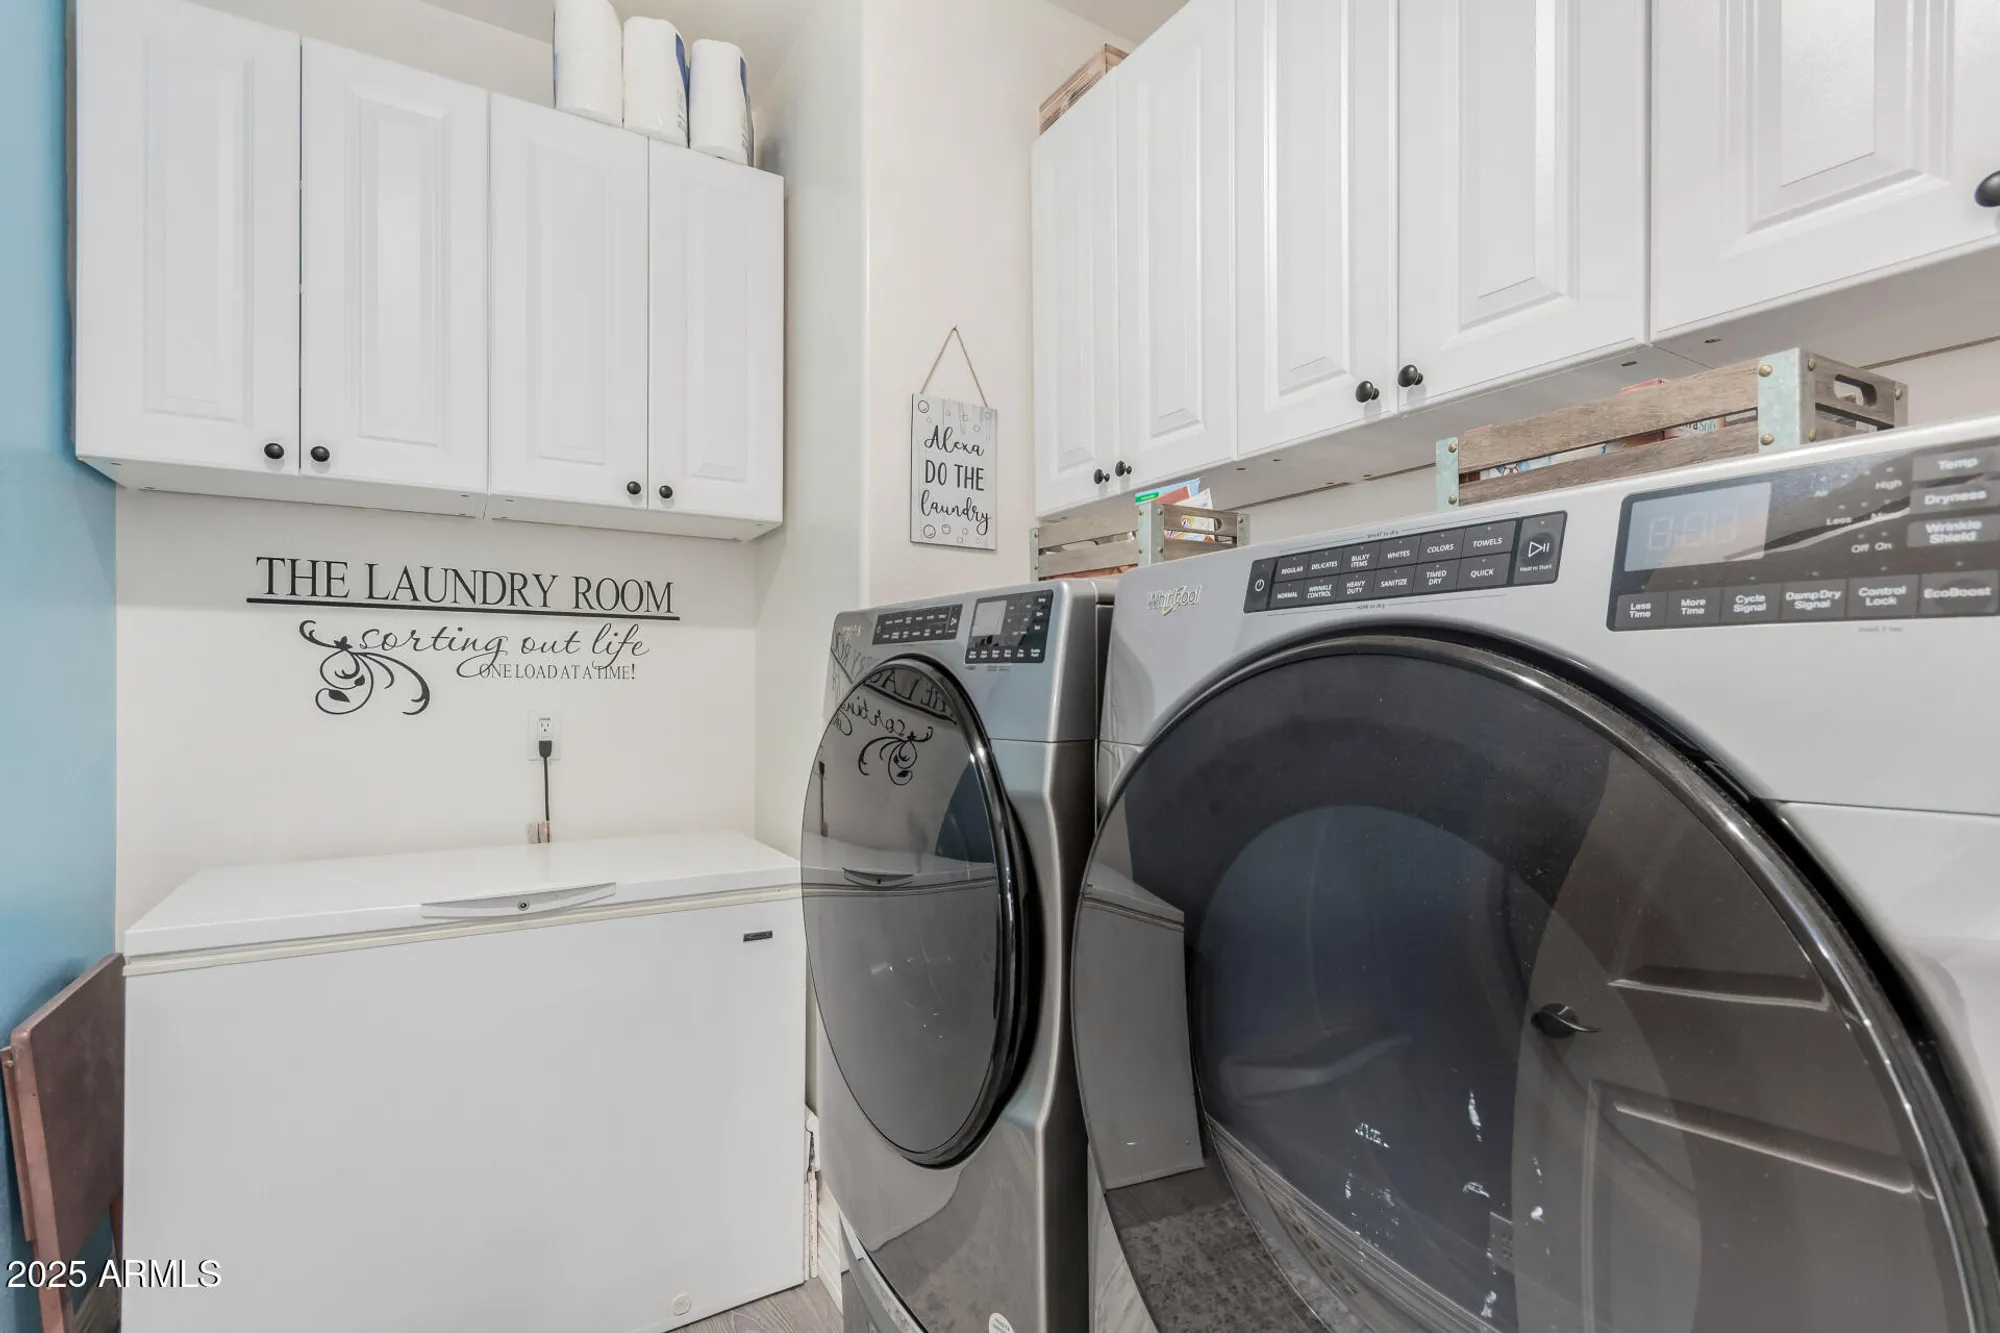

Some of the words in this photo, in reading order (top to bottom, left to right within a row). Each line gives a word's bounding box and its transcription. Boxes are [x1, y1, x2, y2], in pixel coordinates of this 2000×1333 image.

[924, 425, 985, 457] Alexa
[1937, 457, 1978, 470] Temp
[925, 459, 947, 486] DO
[954, 463, 985, 491] THE
[1875, 479, 1903, 490] High
[1924, 490, 1987, 505] Dryness
[920, 489, 992, 536] laundry
[1826, 515, 1852, 526] Less
[1925, 520, 1983, 534] Wrinkle
[1472, 537, 1503, 547] TOWELS
[1929, 531, 1977, 544] Shield
[1427, 543, 1454, 553] COLORS
[1851, 543, 1870, 553] Off
[1874, 541, 1893, 551] On
[1351, 553, 1370, 562] BULKY
[1387, 550, 1411, 560] WHITES
[1311, 561, 1338, 570] DELICATES
[1351, 560, 1368, 568] ITEMS
[1281, 566, 1303, 575] REGULAR
[1426, 570, 1447, 579] TIMED
[1470, 568, 1494, 578] QUICK
[256, 556, 350, 598] THE
[365, 562, 558, 610] LAUNDRY
[573, 575, 675, 614] ROOM
[1346, 580, 1365, 588] HEAVY
[1380, 578, 1408, 588] SANITIZE
[1428, 577, 1442, 586] DRY
[1308, 584, 1332, 592] WRINKLE
[1347, 587, 1363, 595] DUTY
[1858, 585, 1908, 597] Control
[1924, 586, 1992, 599] EcoBoost
[1277, 592, 1298, 600] NORMAL
[1307, 591, 1331, 599] CONTROL
[1735, 594, 1766, 604] Cycle
[1785, 591, 1819, 601] Damp
[1820, 589, 1842, 600] Dry
[1147, 585, 1202, 616] Whirlpool
[1680, 598, 1706, 607] More
[1794, 599, 1831, 611] Signal
[1865, 596, 1897, 606] Lock
[1630, 601, 1651, 611] Less
[1680, 606, 1705, 615] Time
[1733, 602, 1766, 613] Signal
[1629, 610, 1651, 618] Time
[358, 626, 508, 679] sorting
[521, 630, 582, 655] out
[591, 622, 651, 670] life
[479, 663, 512, 679] ONE
[515, 664, 558, 679] LOAD
[560, 664, 581, 680] AT
[582, 665, 593, 680] A
[595, 663, 635, 680] TIME!
